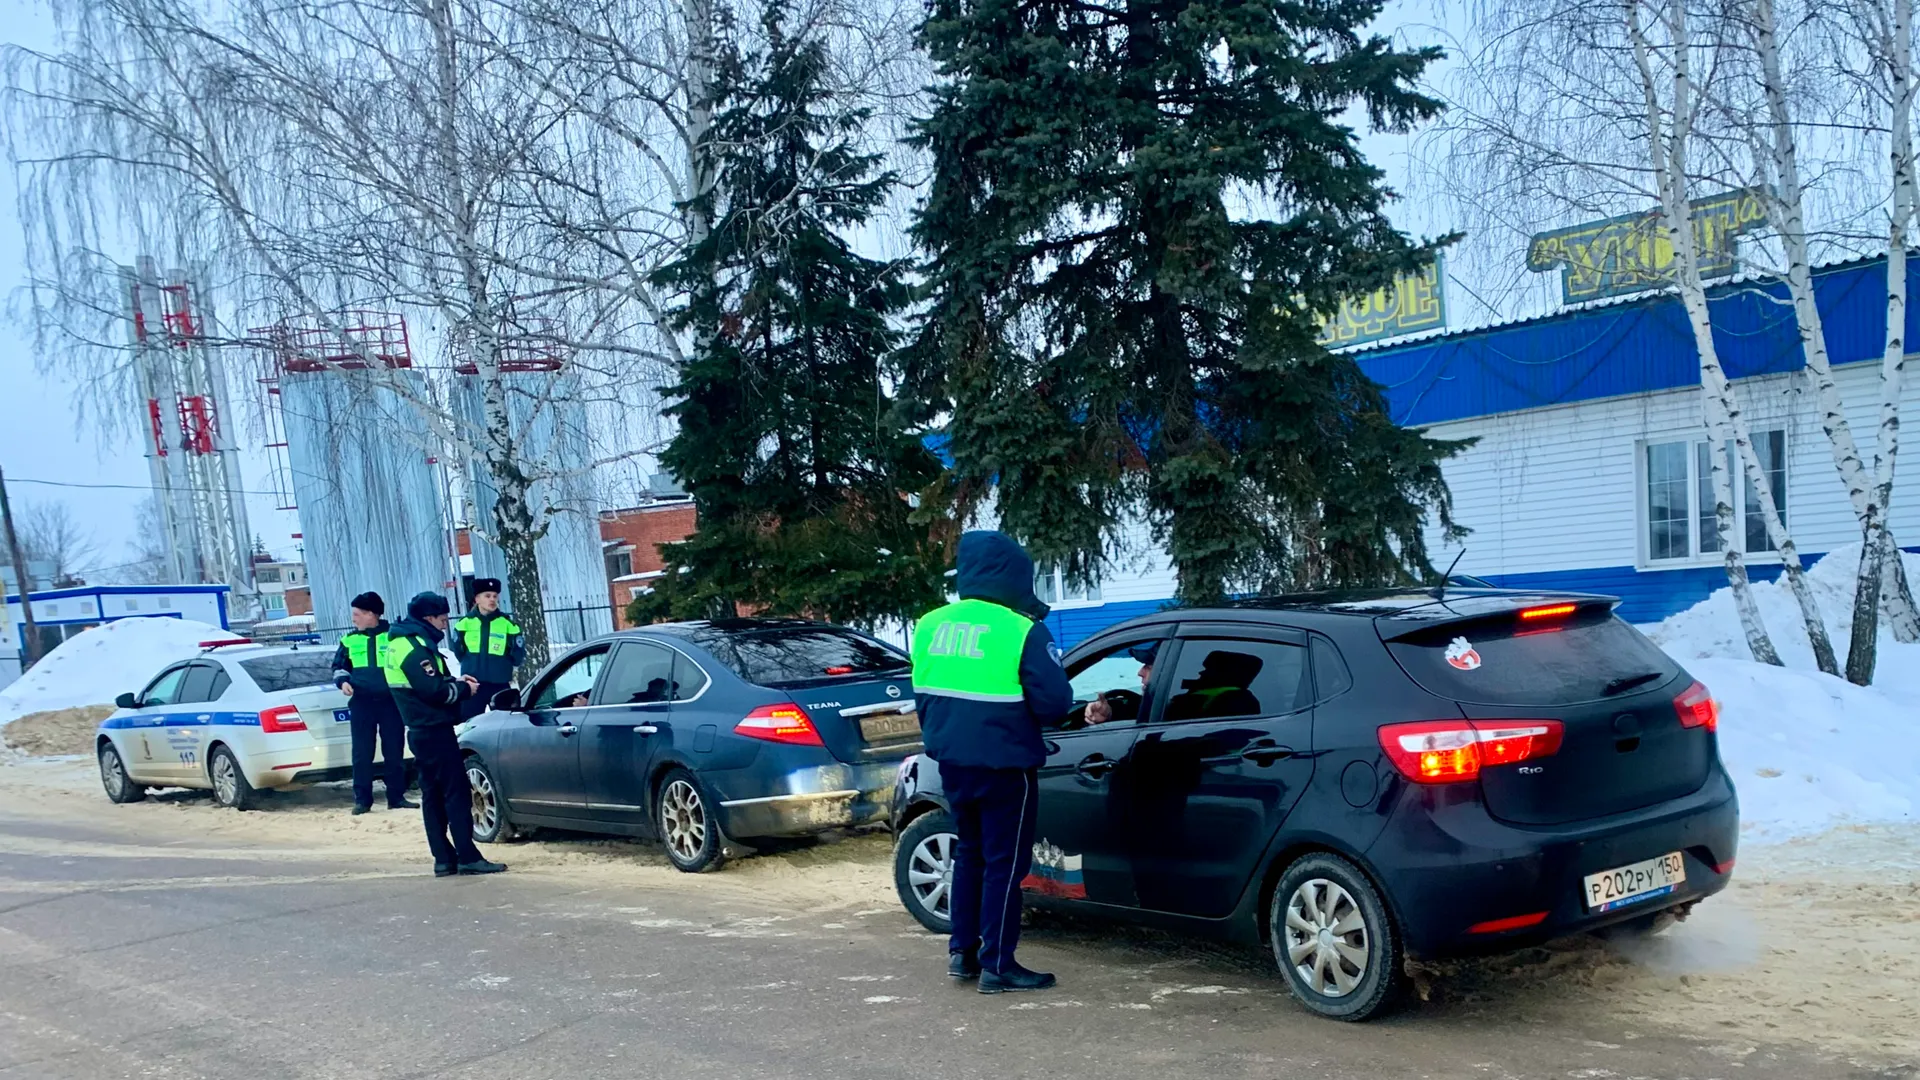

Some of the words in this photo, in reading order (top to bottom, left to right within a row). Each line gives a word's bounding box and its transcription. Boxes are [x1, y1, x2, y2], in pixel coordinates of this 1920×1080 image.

[928, 621, 990, 659] ДПС
[806, 701, 842, 710] TEANA
[179, 751, 197, 768] 112
[1591, 868, 1654, 902] Р202РУ
[1657, 855, 1681, 876] 150
